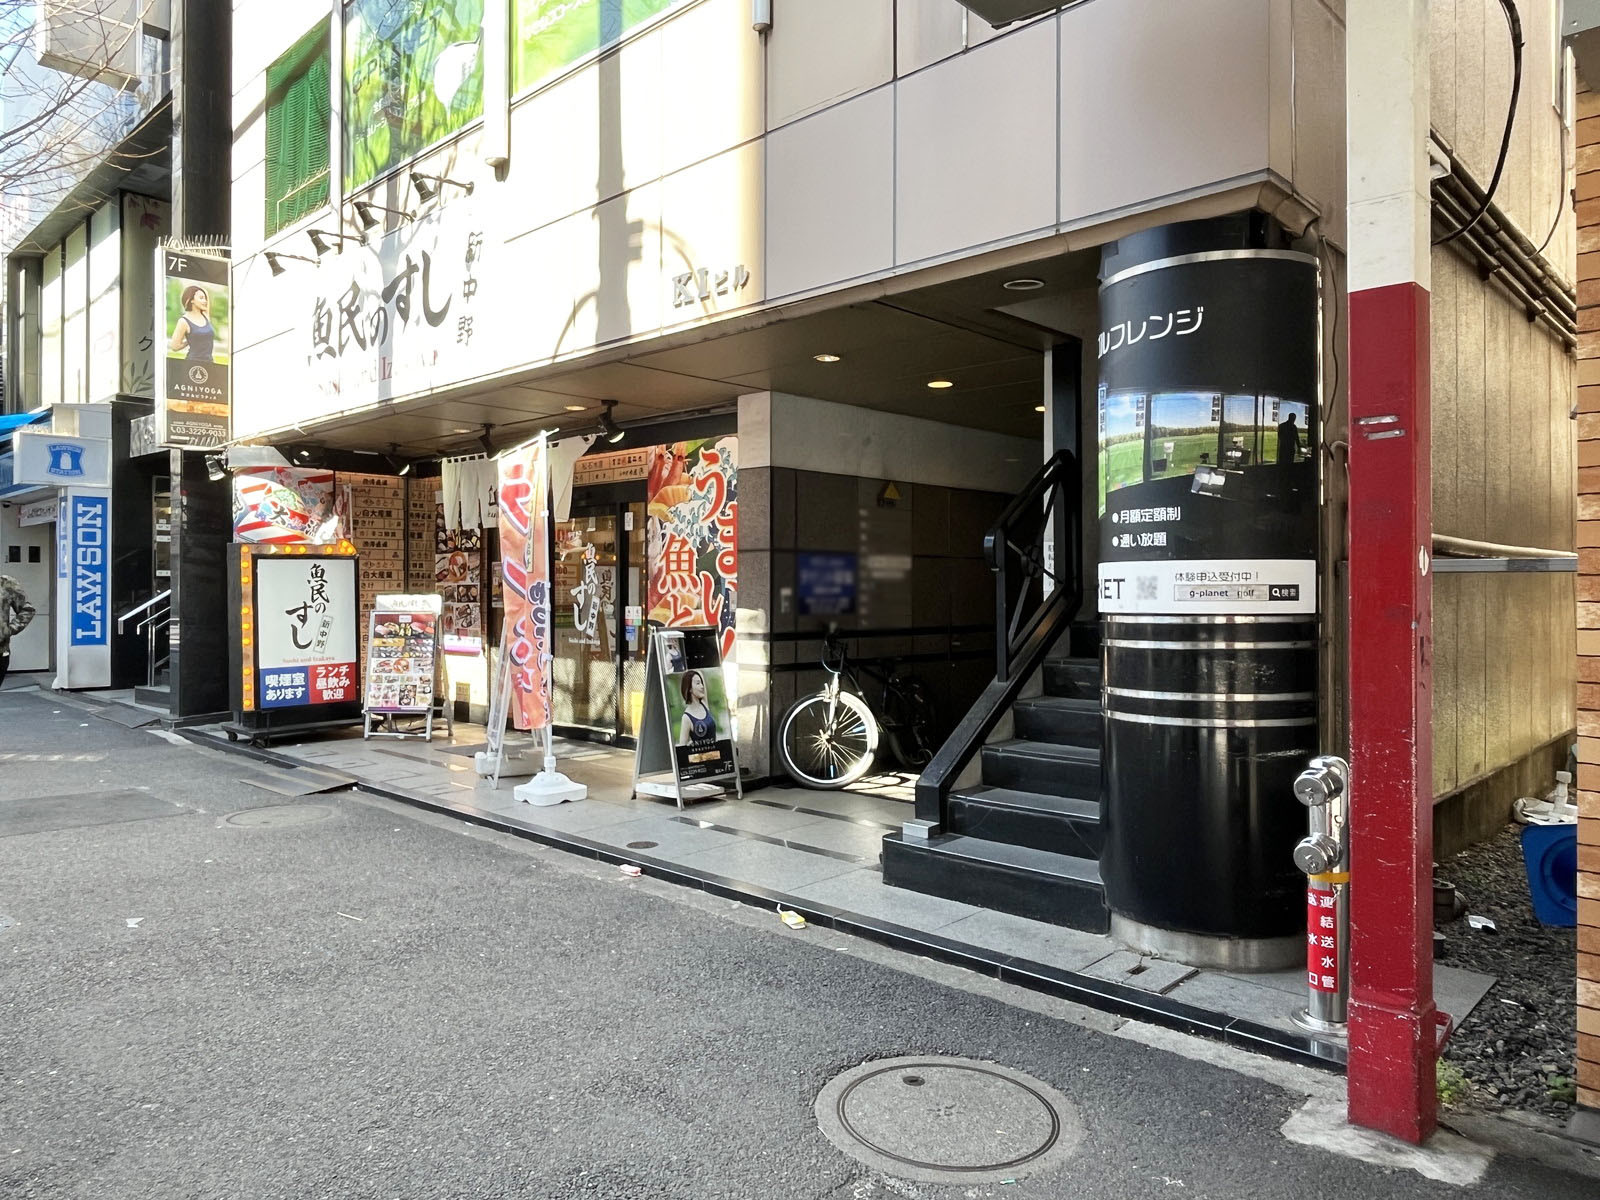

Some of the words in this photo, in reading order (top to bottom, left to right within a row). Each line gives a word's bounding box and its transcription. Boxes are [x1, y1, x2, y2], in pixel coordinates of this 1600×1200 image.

[168, 256, 187, 272] 7F
[174, 384, 222, 395] AGNIYOGA
[1120, 506, 1181, 523] 月額定額制
[1120, 532, 1167, 548] 通い放題
[76, 503, 102, 639] LAWSON
[307, 563, 330, 613] 魚民の
[1189, 588, 1229, 598] g-planet
[1281, 588, 1297, 597] 検索
[285, 601, 313, 649] すし
[316, 665, 350, 678] ランチ
[265, 673, 306, 688] 喫煙室
[315, 677, 350, 690] 昼飲み
[265, 687, 306, 701] あります
[322, 689, 345, 700] 歓迎
[1320, 895, 1335, 989] 連結送水管
